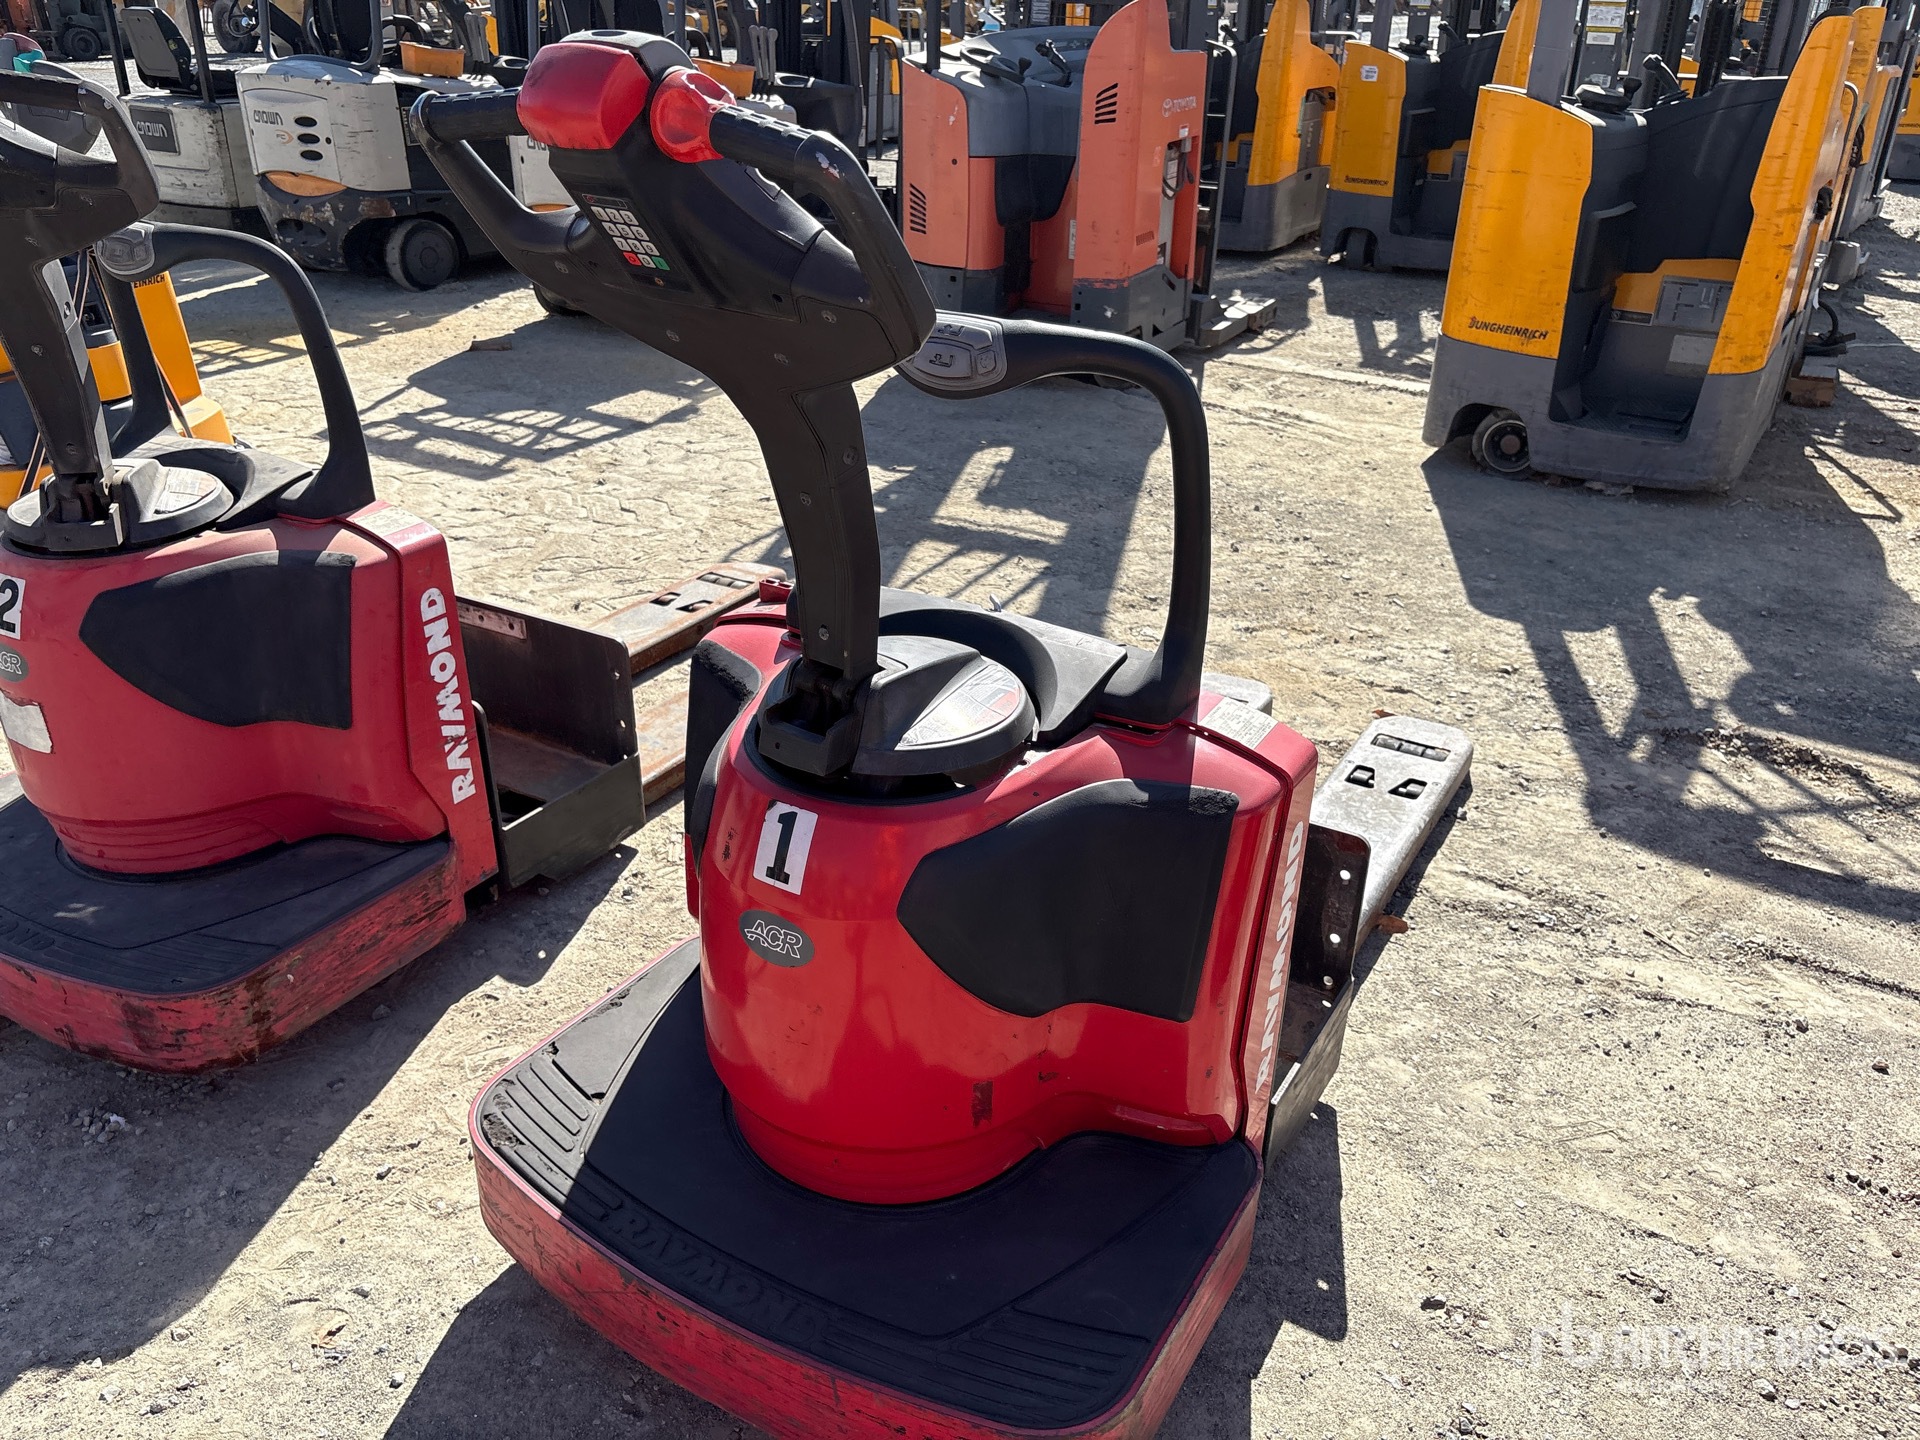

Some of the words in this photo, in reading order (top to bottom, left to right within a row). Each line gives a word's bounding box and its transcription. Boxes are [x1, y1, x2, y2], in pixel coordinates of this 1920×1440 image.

[253, 110, 284, 126] CROWN
[134, 273, 166, 289] EINRICH
[1468, 316, 1550, 340] JUNGHEINRICH
[0, 578, 20, 634] 2
[0, 651, 22, 675] CR
[420, 586, 477, 806] RAYMOND
[765, 810, 799, 885] 1
[744, 919, 803, 959] ACR
[1254, 820, 1304, 1095] RAYMOND
[608, 1205, 817, 1344] RAYMOND
